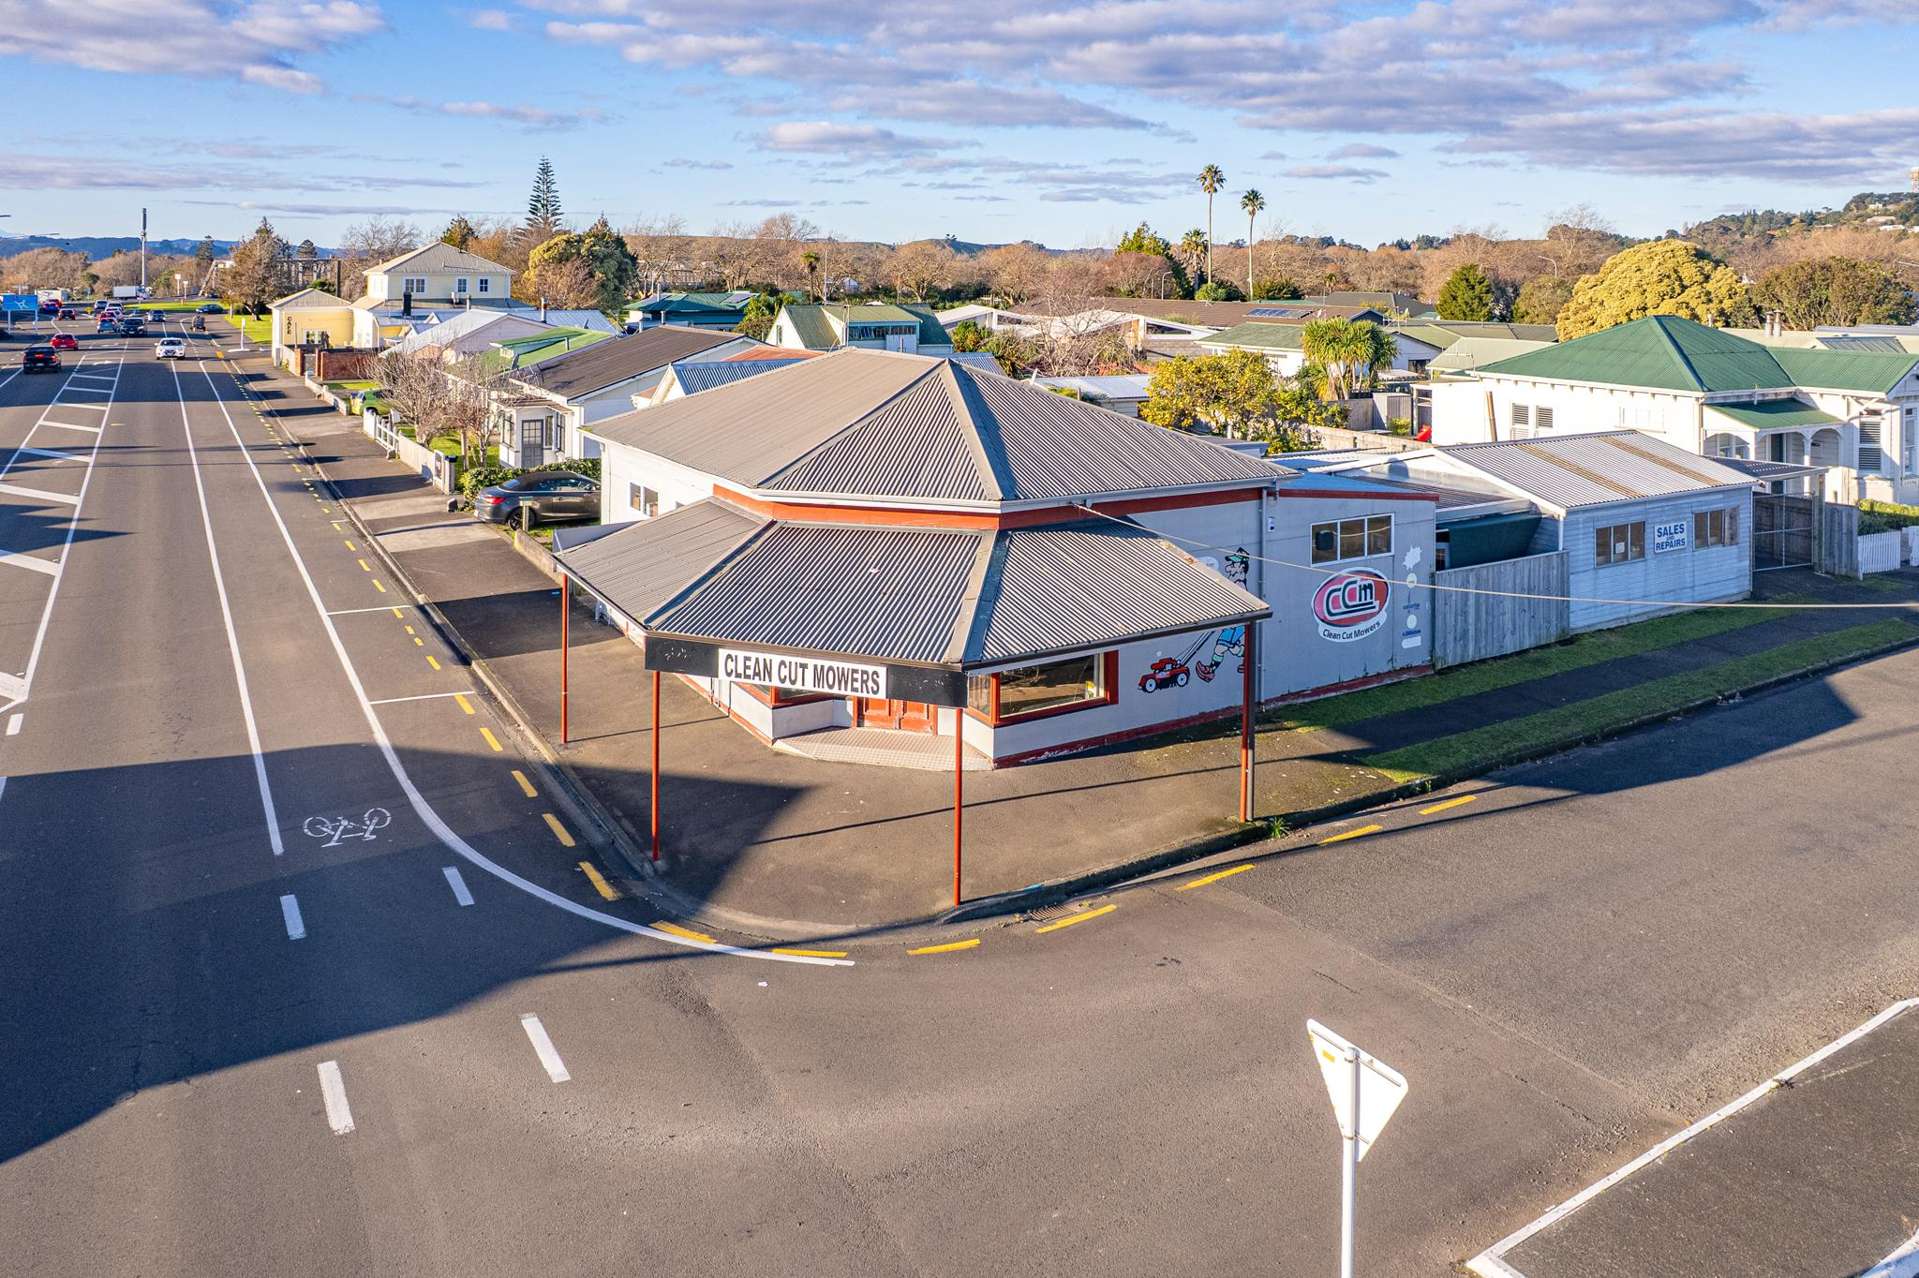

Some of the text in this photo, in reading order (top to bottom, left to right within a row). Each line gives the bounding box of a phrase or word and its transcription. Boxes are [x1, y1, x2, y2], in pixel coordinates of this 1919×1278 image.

[1657, 523, 1685, 538] SALES
[1656, 538, 1686, 551] REPAIRS
[1323, 621, 1380, 640] Clean Cut Mowers
[724, 653, 881, 696] CLEAN CUT MOWERS
